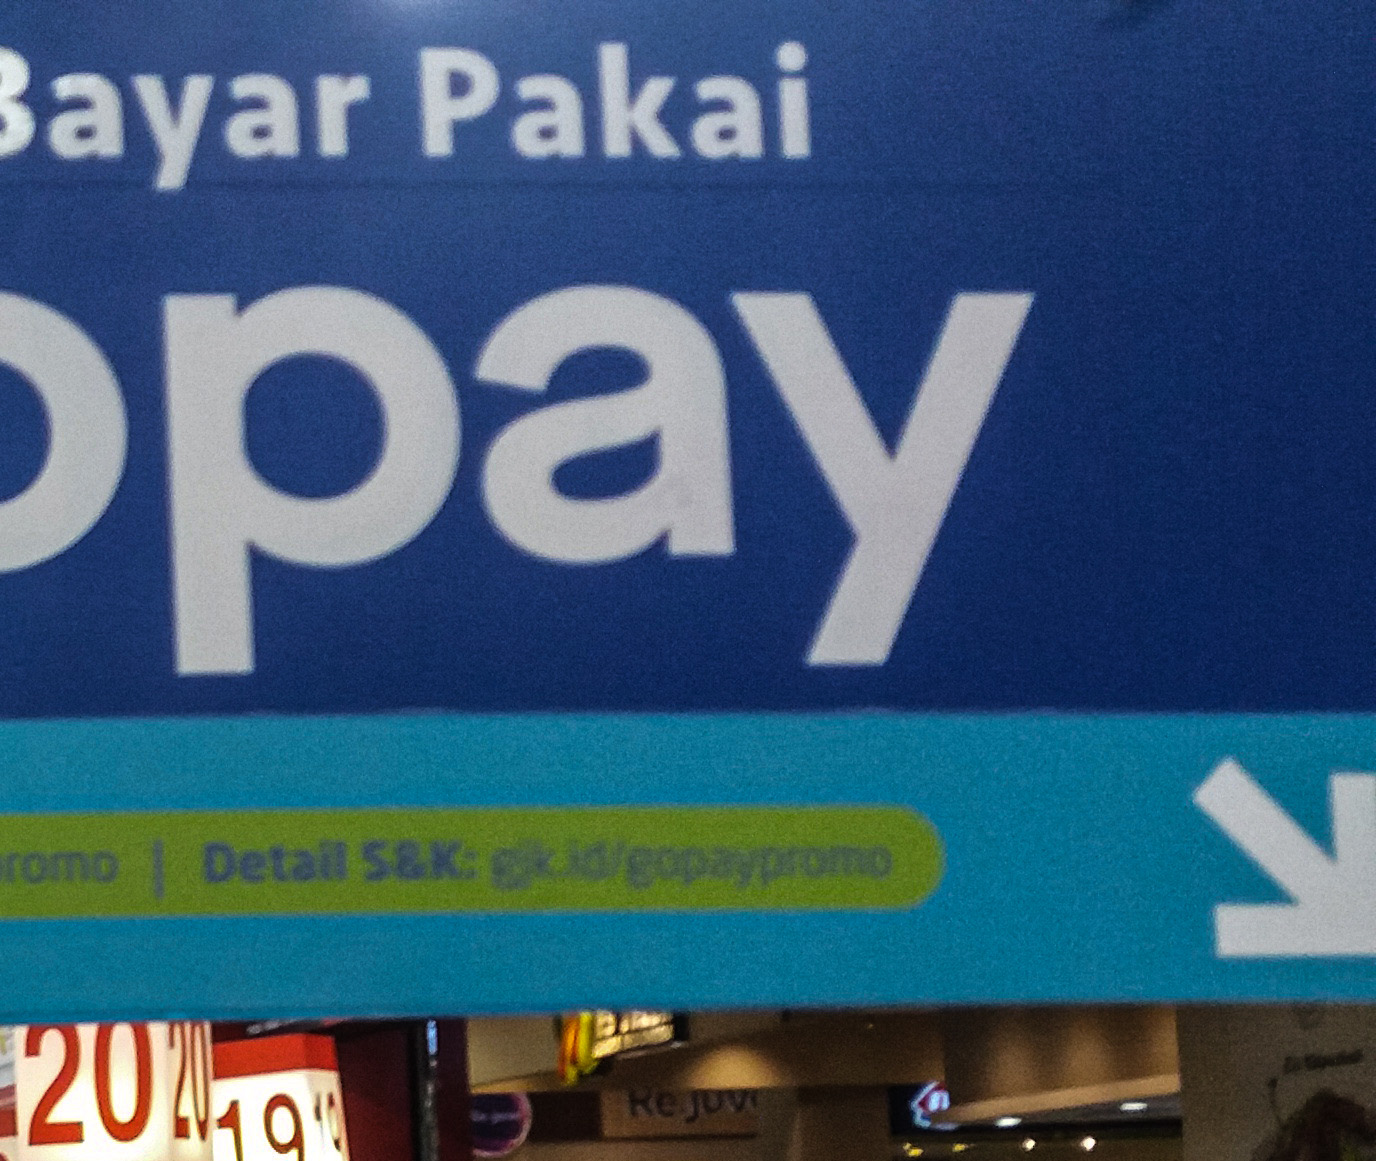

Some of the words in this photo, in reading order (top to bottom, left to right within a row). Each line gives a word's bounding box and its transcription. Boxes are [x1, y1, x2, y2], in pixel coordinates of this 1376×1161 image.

[420, 42, 808, 159] Pakai
[201, 840, 347, 884] Detail
[362, 839, 477, 883] S&K:
[25, 1023, 154, 1146] 20
[168, 1023, 211, 1142] 20
